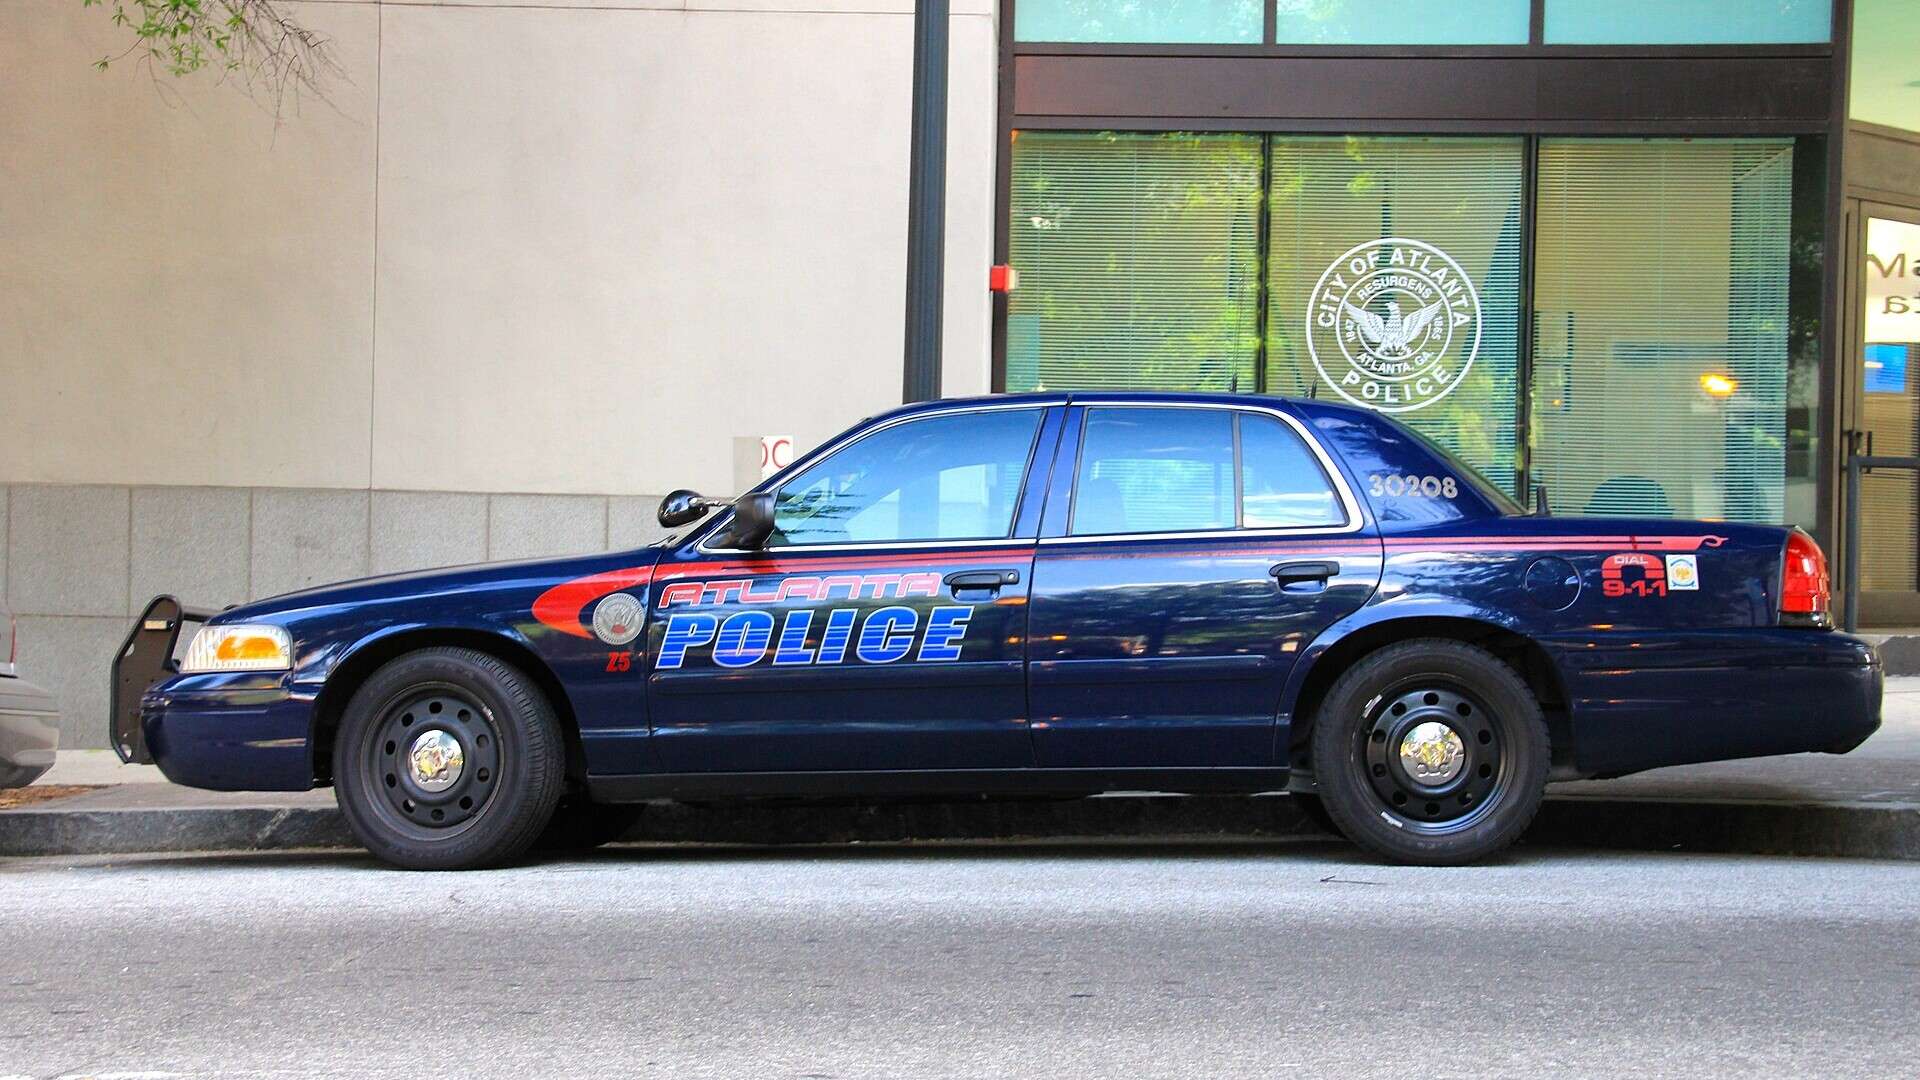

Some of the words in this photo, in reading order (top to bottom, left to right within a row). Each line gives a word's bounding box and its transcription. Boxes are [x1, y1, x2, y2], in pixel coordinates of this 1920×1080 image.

[1317, 273, 1348, 327] CITY
[1350, 250, 1380, 275] OF
[1389, 247, 1471, 327] ATLANTA
[1356, 276, 1433, 301] RESURGENS
[1341, 364, 1452, 403] POLICE
[1368, 474, 1459, 499] 30208
[1613, 556, 1649, 565] DIAL
[657, 572, 943, 609] ATLANTA
[1603, 579, 1667, 597] 9-1-1
[655, 605, 975, 670] POLICE
